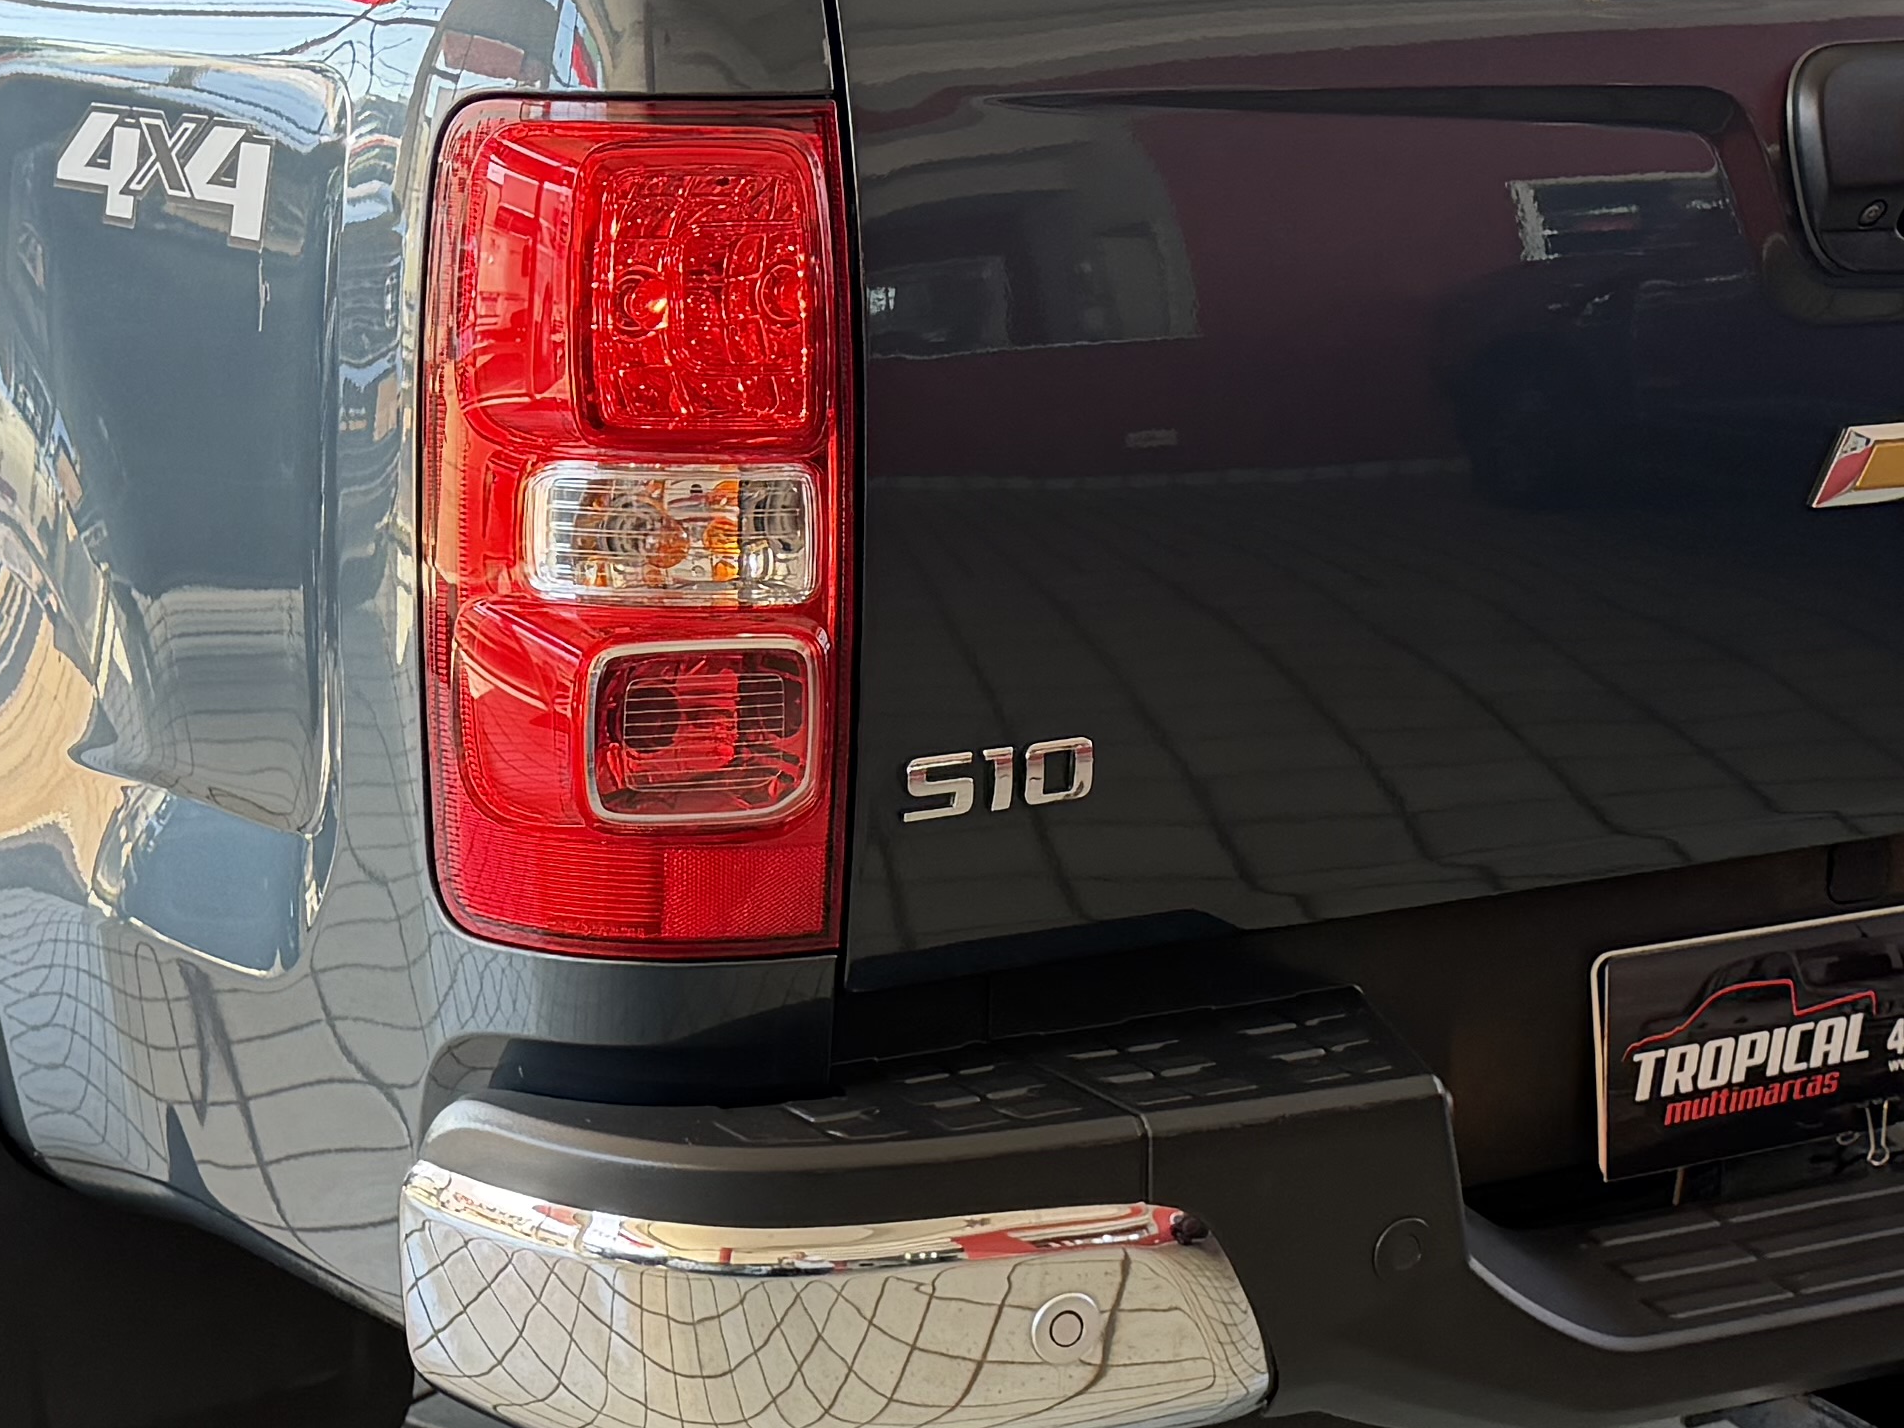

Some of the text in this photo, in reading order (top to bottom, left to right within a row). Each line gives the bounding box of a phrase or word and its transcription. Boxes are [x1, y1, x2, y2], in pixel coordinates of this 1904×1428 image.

[903, 736, 1094, 823] S10
[1633, 1013, 1870, 1102] TROPICAL
[1664, 1072, 1840, 1125] multimarcas
